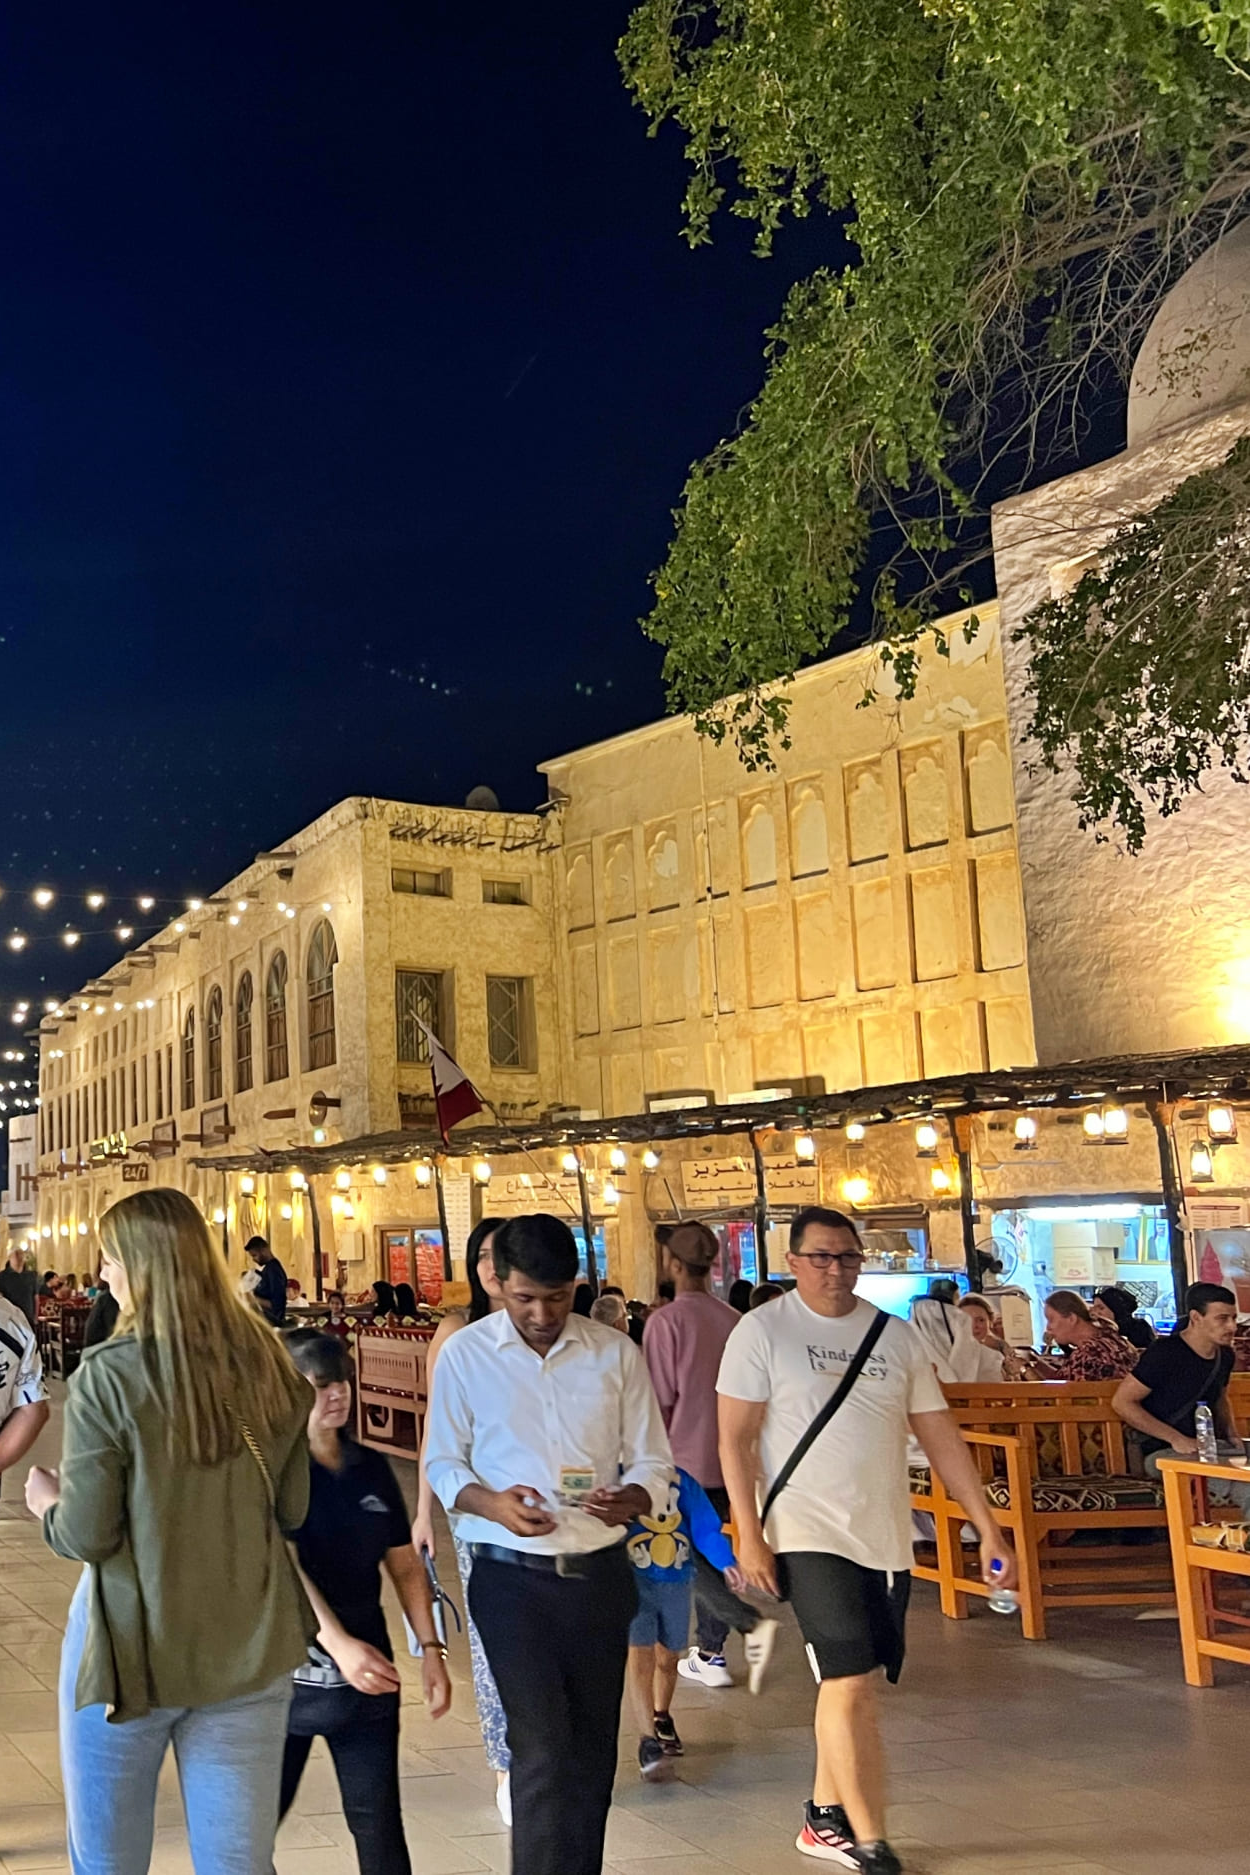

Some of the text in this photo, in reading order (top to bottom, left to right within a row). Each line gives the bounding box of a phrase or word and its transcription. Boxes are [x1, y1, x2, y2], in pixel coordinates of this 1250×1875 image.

[125, 1167, 147, 1180] 24/7
[806, 1344, 887, 1365] Kindss
[810, 1357, 827, 1372] Is
